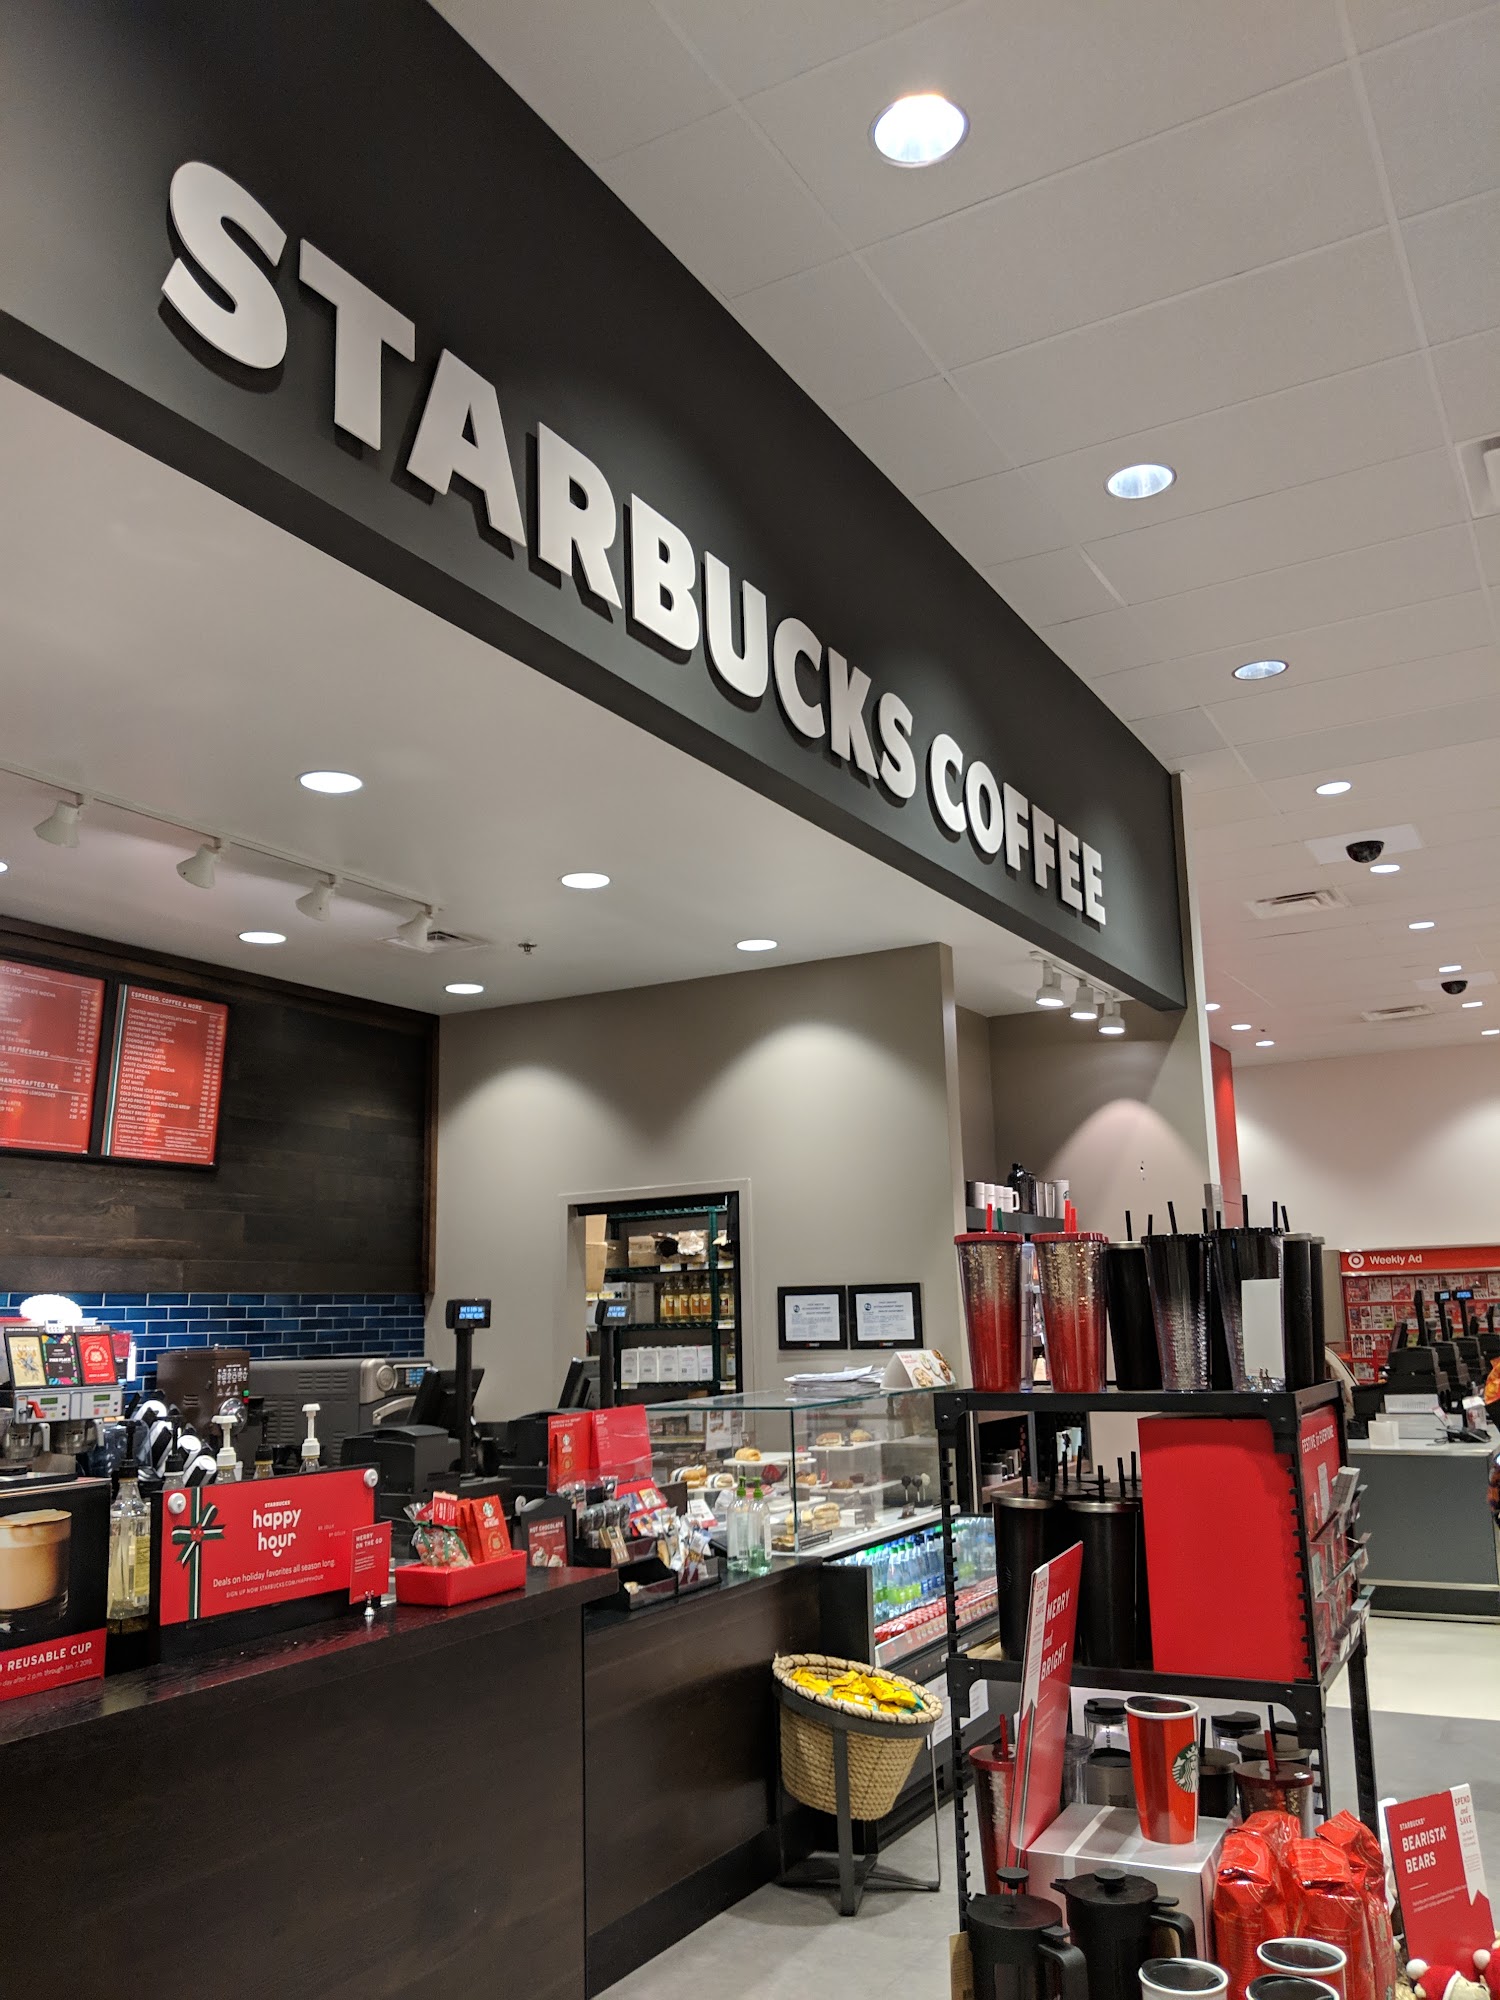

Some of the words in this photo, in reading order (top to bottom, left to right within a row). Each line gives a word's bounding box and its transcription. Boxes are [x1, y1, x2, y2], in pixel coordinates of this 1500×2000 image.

[161, 161, 916, 800] STARBUCKS
[930, 733, 1106, 926] COFFEE
[1370, 1254, 1406, 1266] Weekly
[1408, 1254, 1422, 1264] Ad
[1302, 1434, 1316, 1454] FESTIVE
[1319, 1424, 1334, 1444] EVERYONE
[264, 1500, 290, 1508] STARBUCKS
[252, 1508, 302, 1530] happy
[258, 1532, 296, 1551] hour
[213, 1577, 231, 1588] Deals
[242, 1571, 265, 1583] holiday
[266, 1567, 292, 1578] favorites
[301, 1562, 321, 1572] season
[1046, 1588, 1071, 1623] MERRY
[7, 1648, 66, 1672] REUSABLE
[70, 1642, 92, 1656] CUP
[1041, 1642, 1067, 1682] BRIGHT
[44, 1666, 64, 1676] through
[1454, 1795, 1470, 1806] SPEND
[1460, 1815, 1472, 1826] SAVE
[1405, 1852, 1437, 1873] BEARS
